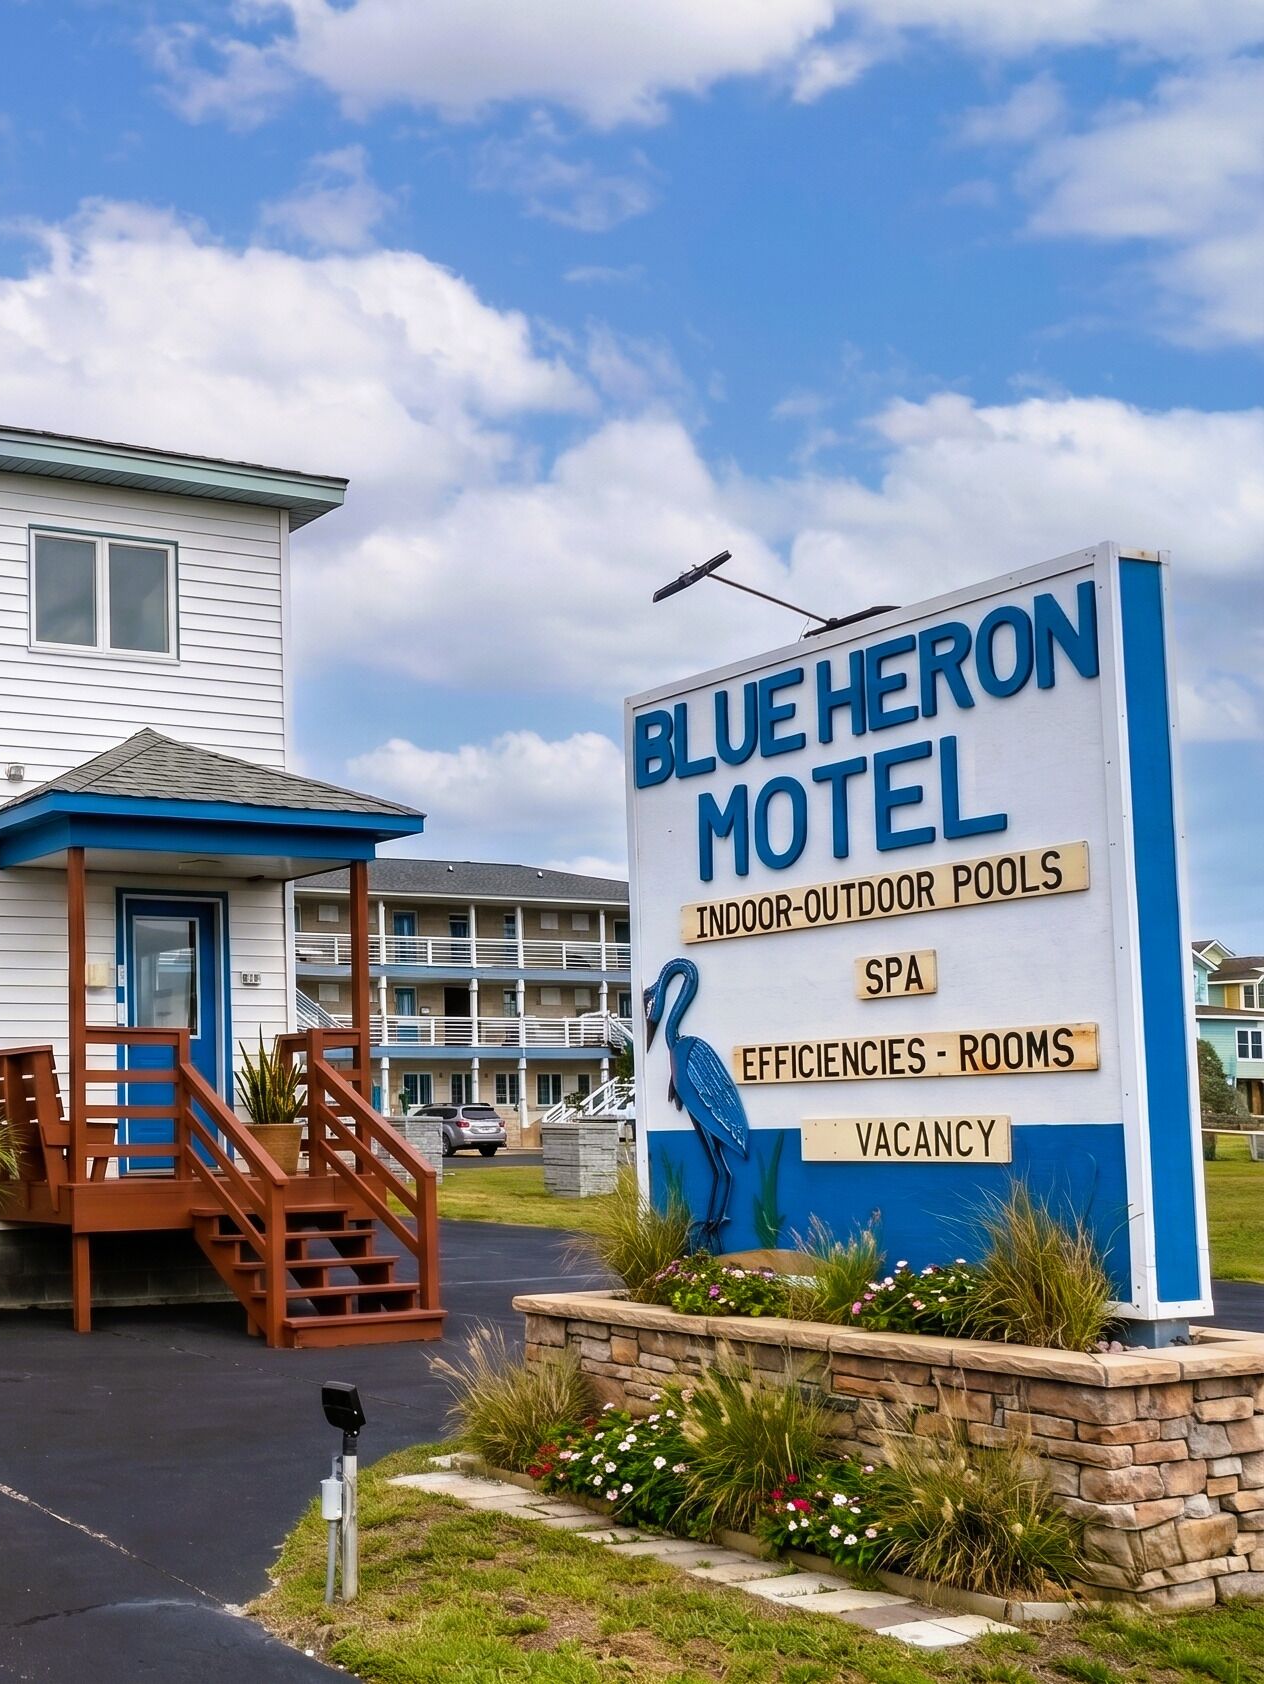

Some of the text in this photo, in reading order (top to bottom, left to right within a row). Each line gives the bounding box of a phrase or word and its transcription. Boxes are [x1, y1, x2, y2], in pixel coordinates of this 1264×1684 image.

[635, 580, 1099, 789] BLUE HERON
[698, 735, 1007, 882] MOTEL
[696, 851, 1063, 938] INDOOR-OUTDOOR POOLS
[865, 955, 924, 995] SPA
[742, 1037, 926, 1081] EFFICIENCIES
[959, 1028, 1074, 1072] ROOMS
[856, 1119, 996, 1157] VACANCY
